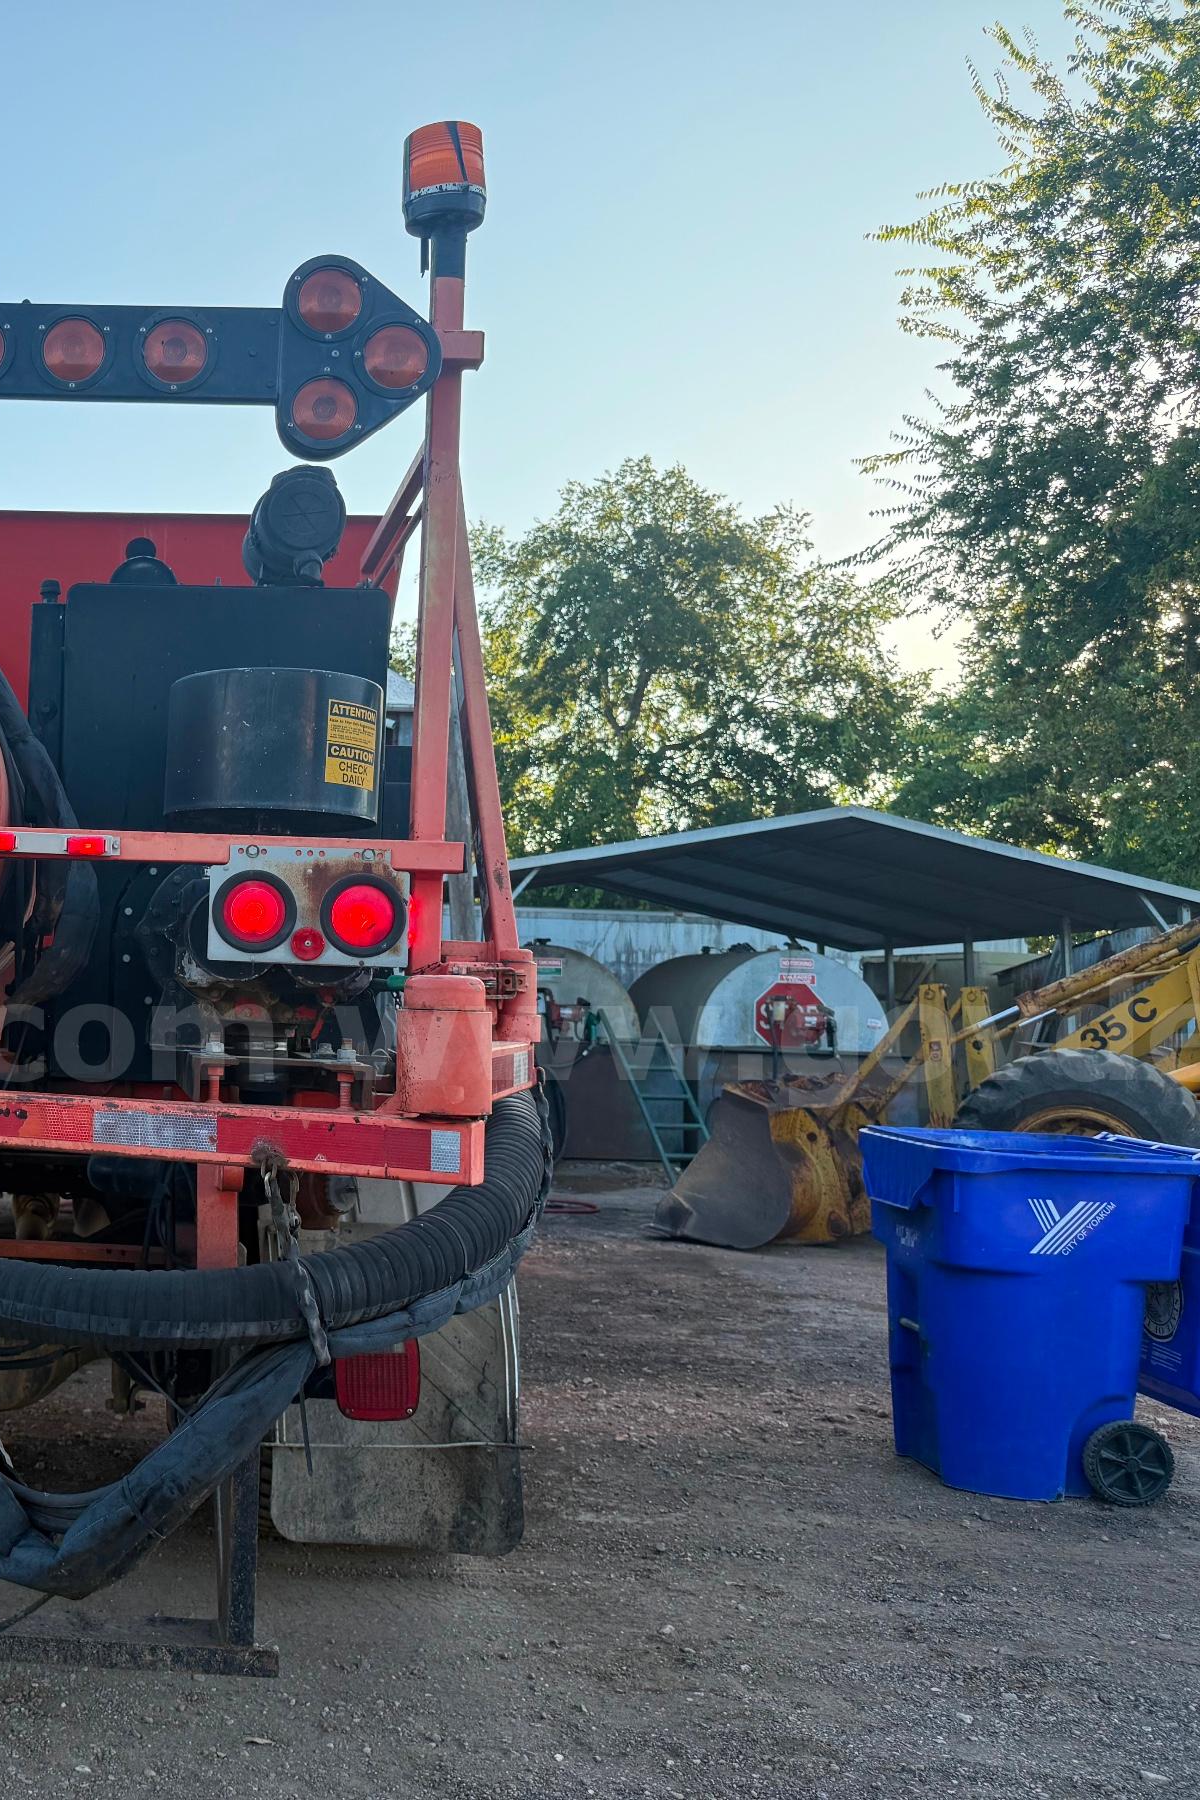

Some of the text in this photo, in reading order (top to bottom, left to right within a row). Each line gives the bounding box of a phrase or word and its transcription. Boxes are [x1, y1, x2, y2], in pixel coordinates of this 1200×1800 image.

[331, 703, 376, 722] ATTENTION
[330, 745, 374, 763] CAUTION
[338, 761, 368, 776] CHECK
[342, 773, 365, 787] DAILY
[1061, 1201, 1117, 1256] CITY OF YOAKUM
